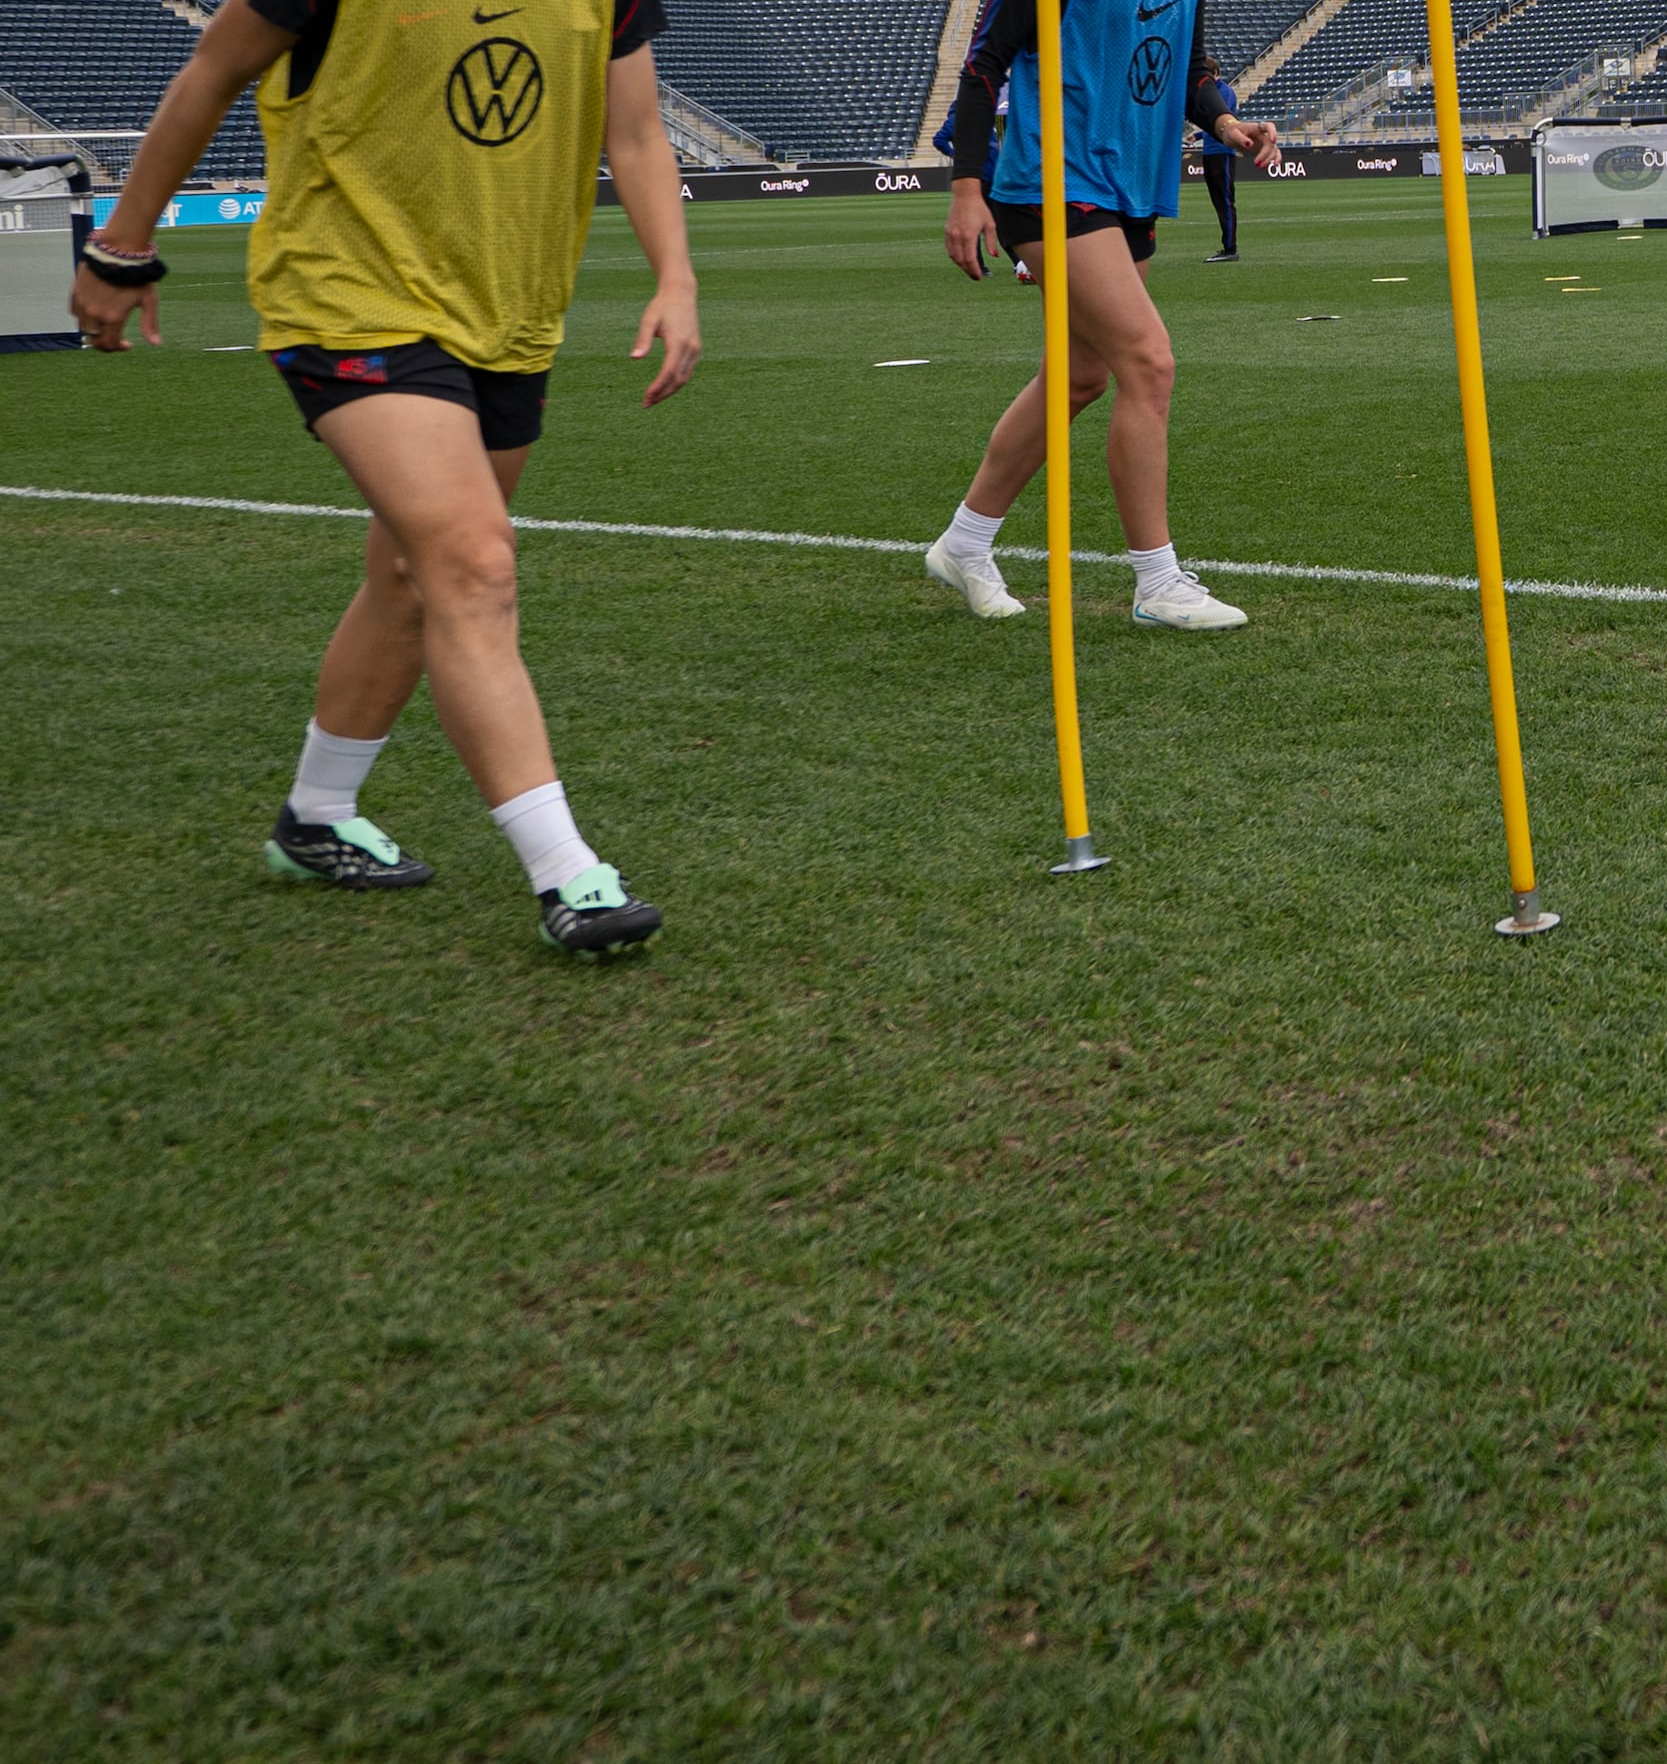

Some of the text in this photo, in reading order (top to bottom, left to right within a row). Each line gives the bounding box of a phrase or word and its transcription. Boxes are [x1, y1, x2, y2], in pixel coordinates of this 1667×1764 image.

[1357, 158, 1392, 172] Oura Ring
[1463, 155, 1496, 172] URA
[1547, 153, 1585, 166] Oura Ring
[760, 178, 803, 193] Oura Ring
[243, 200, 266, 216] AT
